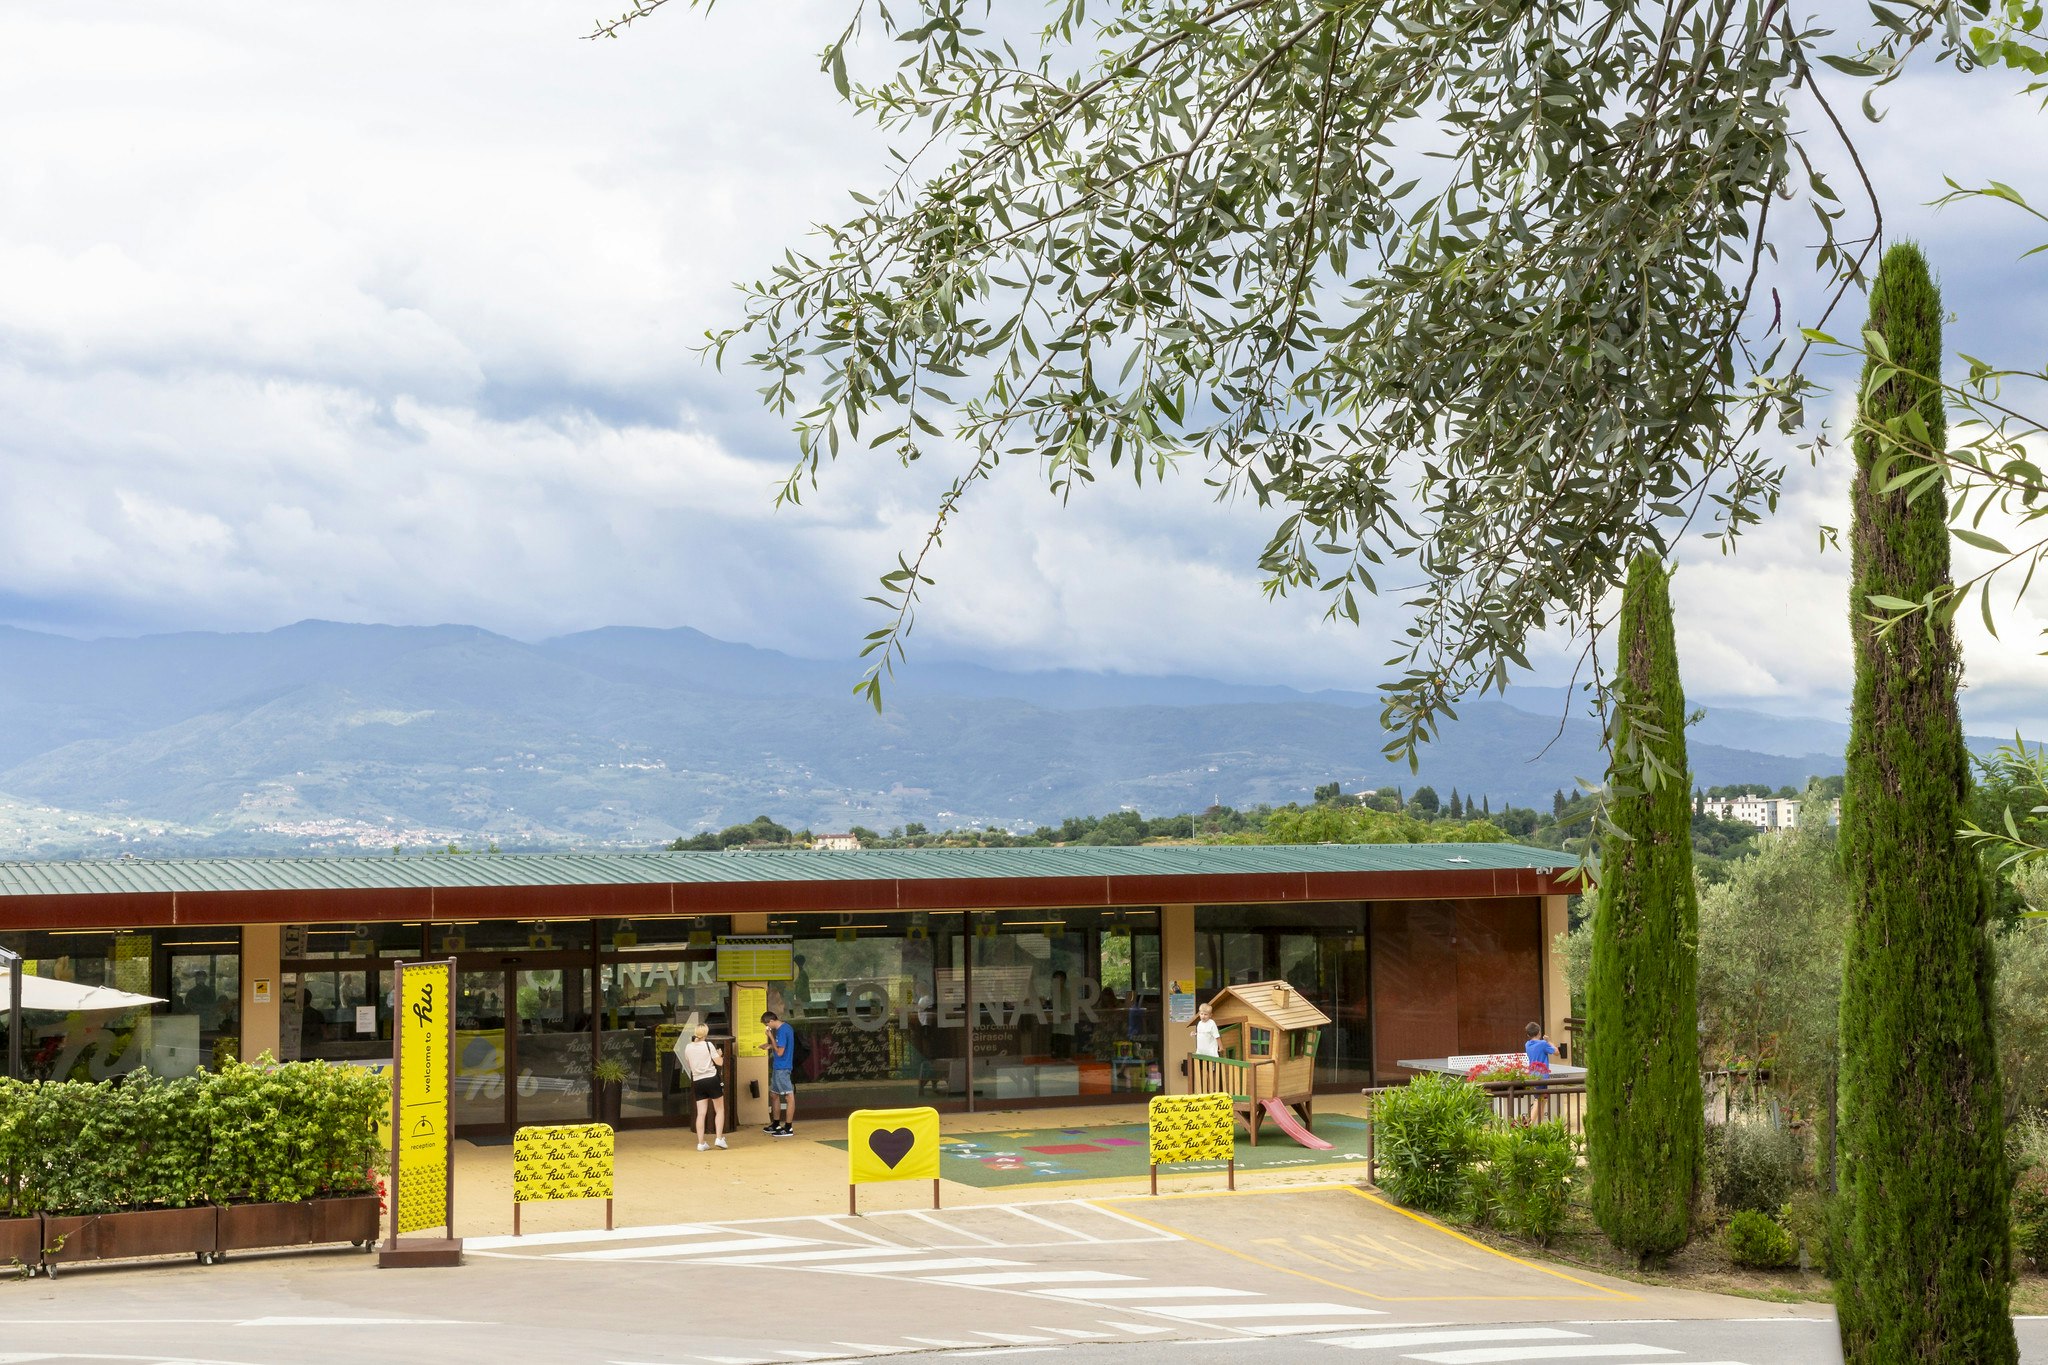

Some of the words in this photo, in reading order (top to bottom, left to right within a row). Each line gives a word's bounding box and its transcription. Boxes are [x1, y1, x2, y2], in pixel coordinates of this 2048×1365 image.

[617, 918, 633, 931] A
[413, 983, 433, 1028] hu
[425, 1032, 431, 1043] to
[971, 1031, 1013, 1042] Girasole
[971, 1043, 998, 1052] oves
[1153, 1103, 1169, 1114] hu
[1170, 1104, 1181, 1112] hu
[1184, 1102, 1199, 1113] hu
[1214, 1100, 1229, 1111] hu
[1153, 1121, 1169, 1132] hu
[1184, 1119, 1199, 1131] hu
[1200, 1120, 1212, 1128] hu
[1214, 1117, 1230, 1128] hu
[530, 1132, 543, 1140] hu
[546, 1130, 565, 1140] hu
[583, 1128, 601, 1139] hu
[410, 1142, 436, 1151] reception
[1153, 1140, 1169, 1151] hu
[1183, 1138, 1199, 1149] hu
[1200, 1138, 1211, 1146] hu
[1213, 1135, 1229, 1146] hu
[530, 1151, 543, 1160] hu
[546, 1148, 565, 1160] hu
[567, 1150, 580, 1158] hu
[583, 1147, 601, 1159] hu
[530, 1171, 543, 1180] hu
[546, 1168, 565, 1180] hu
[566, 1170, 579, 1178] hu
[582, 1166, 601, 1179] hu
[530, 1191, 543, 1199] hu
[546, 1188, 564, 1199] hu
[566, 1190, 578, 1198] hu
[582, 1186, 600, 1198] hu
